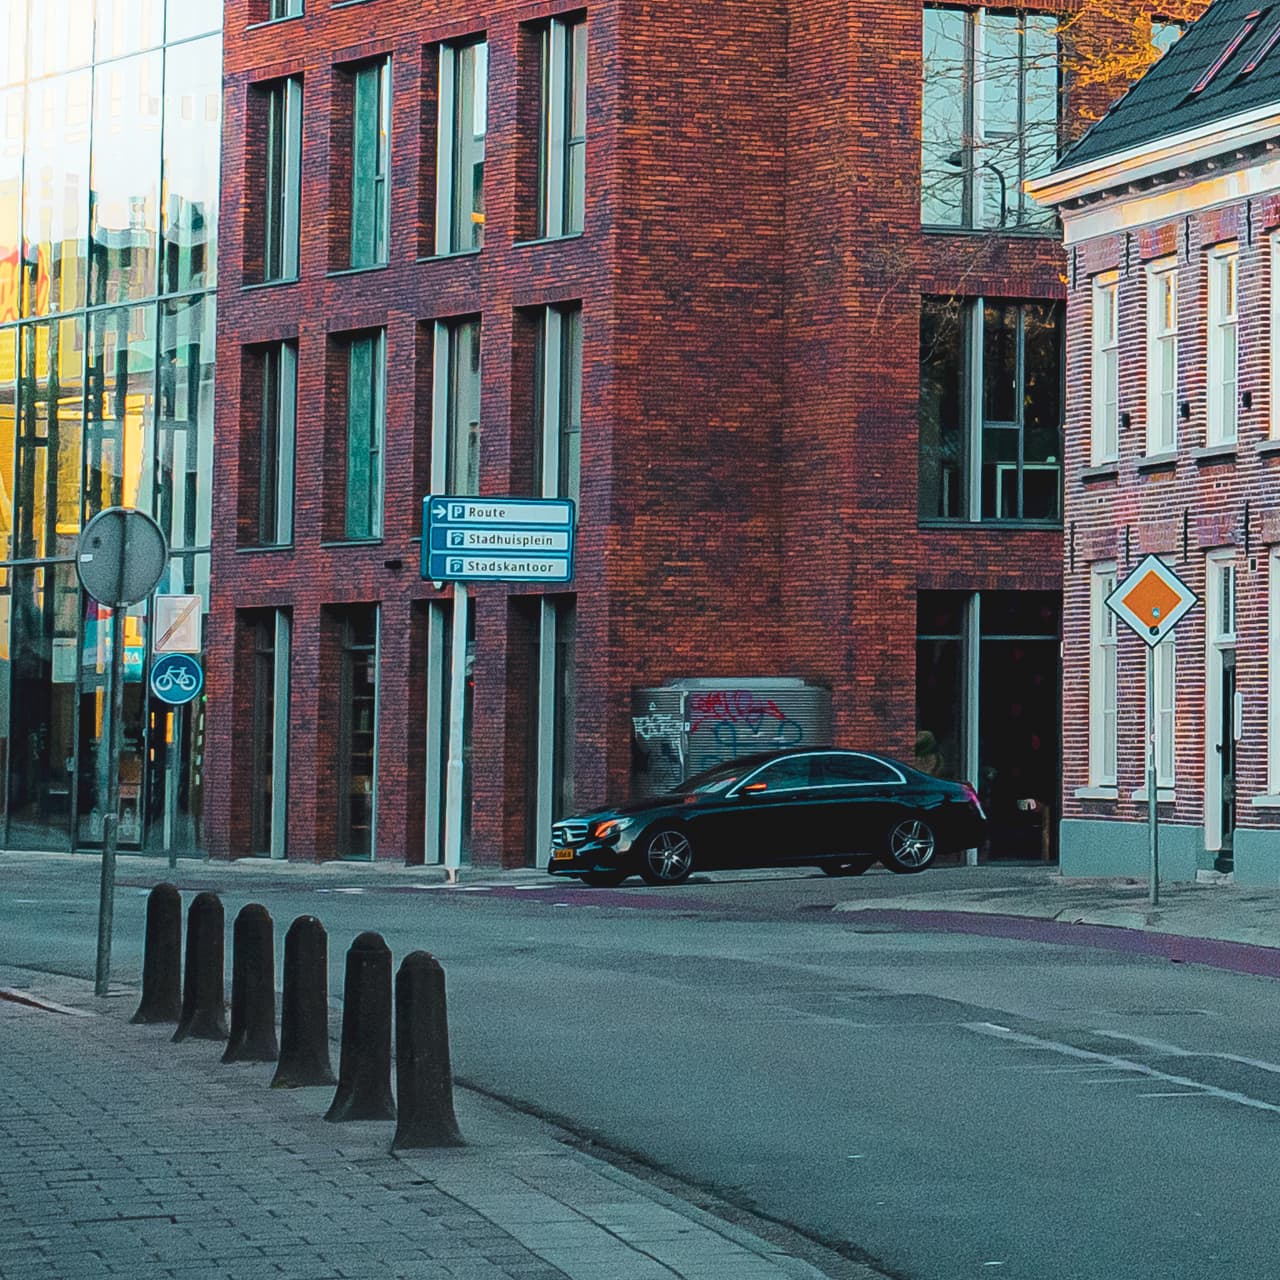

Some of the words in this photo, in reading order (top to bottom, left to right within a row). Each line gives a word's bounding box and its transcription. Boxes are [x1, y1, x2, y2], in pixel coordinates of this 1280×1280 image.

[469, 507, 505, 518] Route
[469, 534, 553, 547] Stadhuisplein
[468, 561, 553, 572] Stadskantoor
